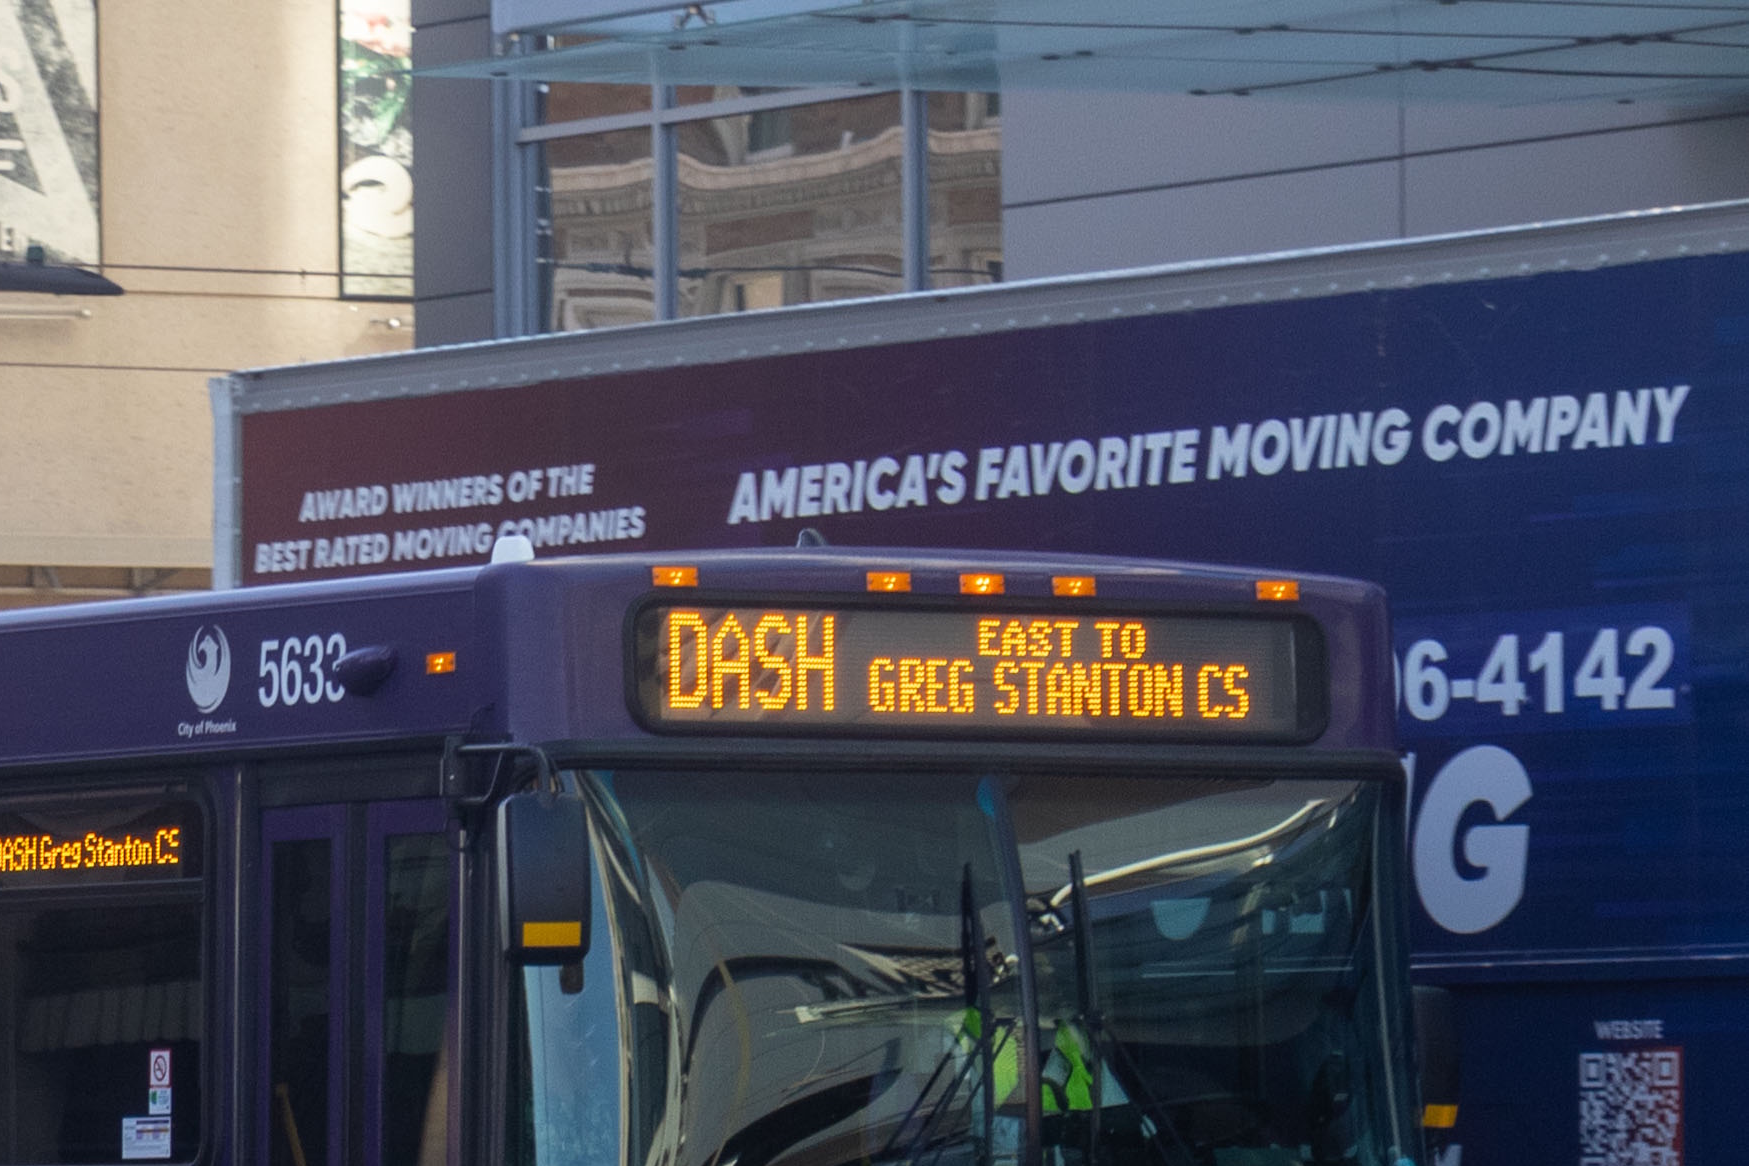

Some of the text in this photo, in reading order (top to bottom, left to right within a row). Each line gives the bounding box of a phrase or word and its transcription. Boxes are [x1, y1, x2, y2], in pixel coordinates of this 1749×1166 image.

[727, 385, 1691, 525] AMERICA'S FAVORITE MOVING COMPANY
[299, 463, 596, 522] AWARD WINNERS OF THE
[254, 540, 311, 574] BEST
[314, 532, 390, 569] RATED
[392, 522, 493, 562] MOVING
[668, 611, 836, 712] DASH
[979, 619, 1147, 659] EAST TO
[258, 632, 347, 708] 5633
[868, 657, 1250, 719] GREG STANTON CS
[1394, 625, 1675, 721] 6-4142
[177, 718, 237, 738] City of Phoenix
[40, 835, 82, 870] Greg
[84, 832, 153, 868] Stanton
[155, 827, 180, 864] CS
[1593, 1019, 1664, 1039] WEBSITE
